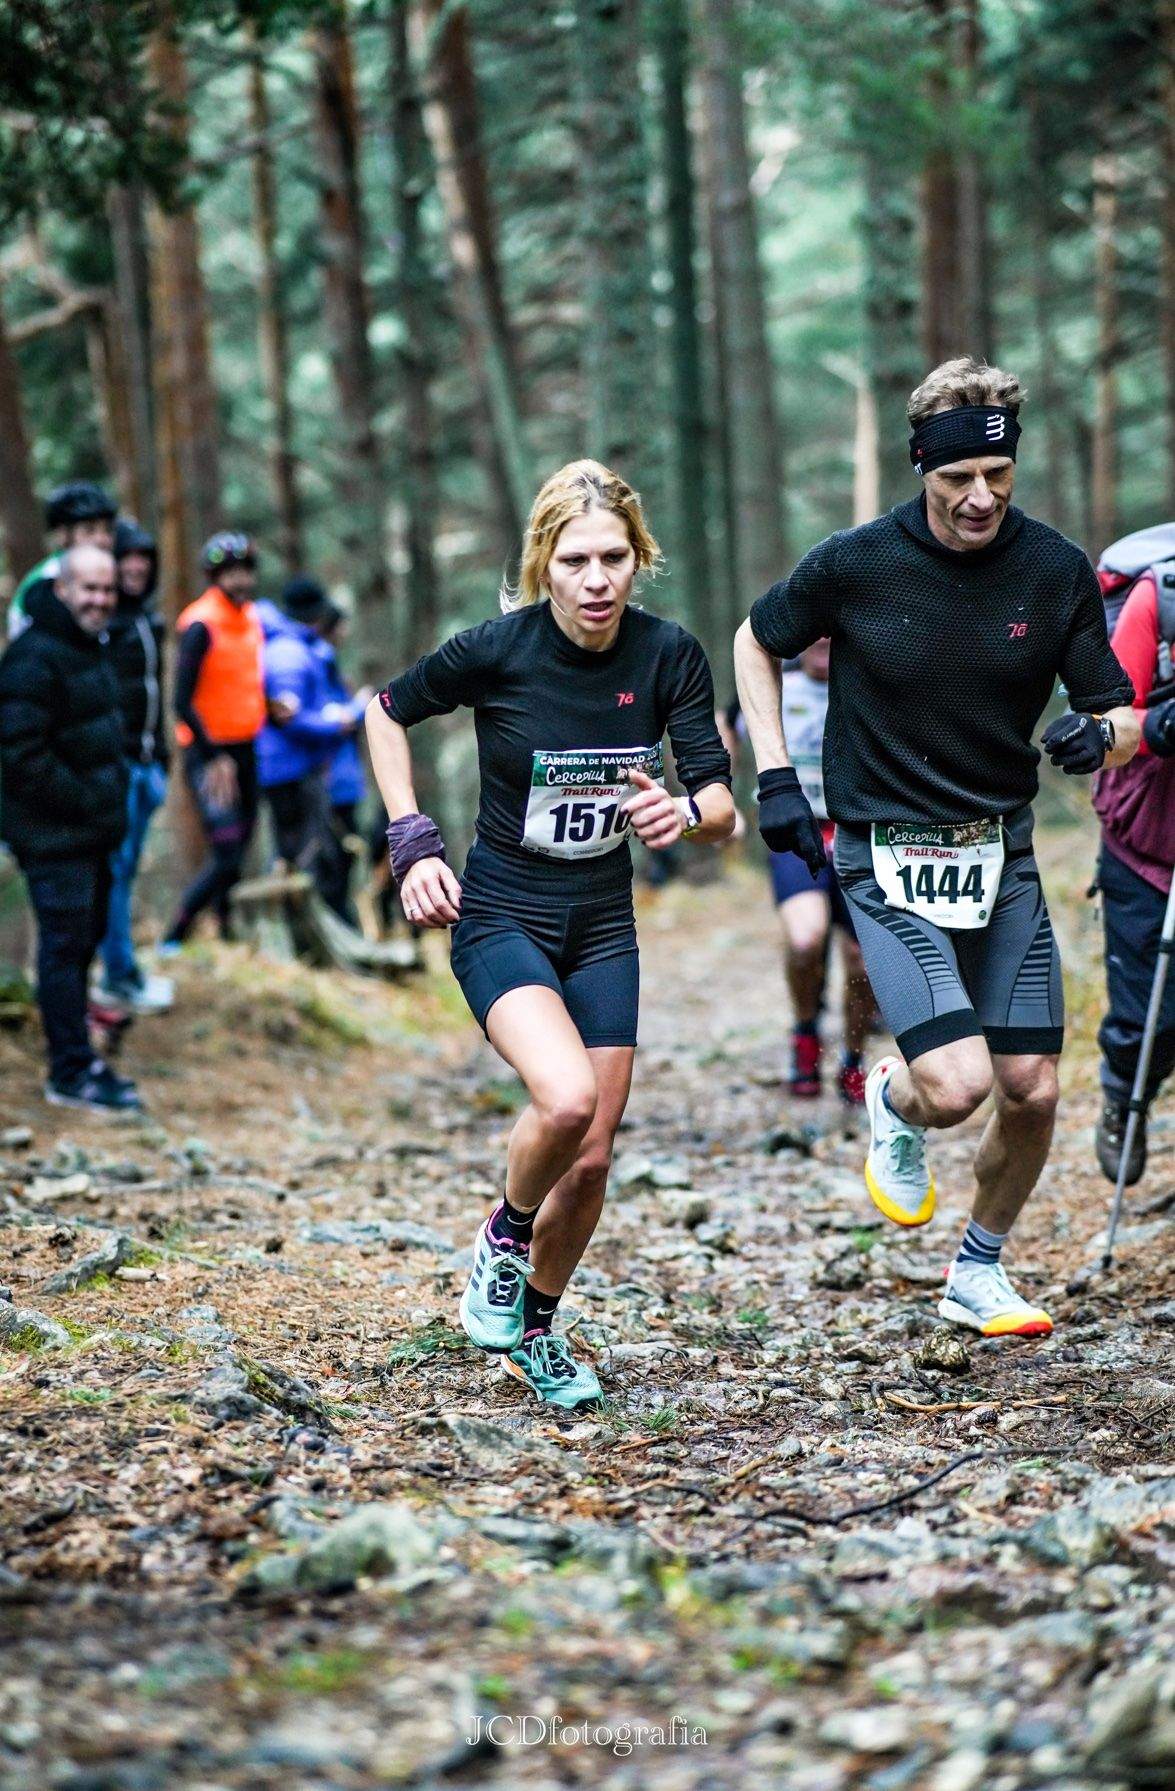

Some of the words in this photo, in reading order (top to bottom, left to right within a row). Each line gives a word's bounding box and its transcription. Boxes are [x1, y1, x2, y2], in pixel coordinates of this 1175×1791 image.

[616, 693, 634, 707] 76
[540, 756, 586, 766] CARRERA
[588, 758, 599, 766] DE
[602, 755, 645, 766] NAVIDAD
[561, 787, 589, 797] Trail
[902, 847, 929, 857] Trail
[896, 864, 985, 904] 1444
